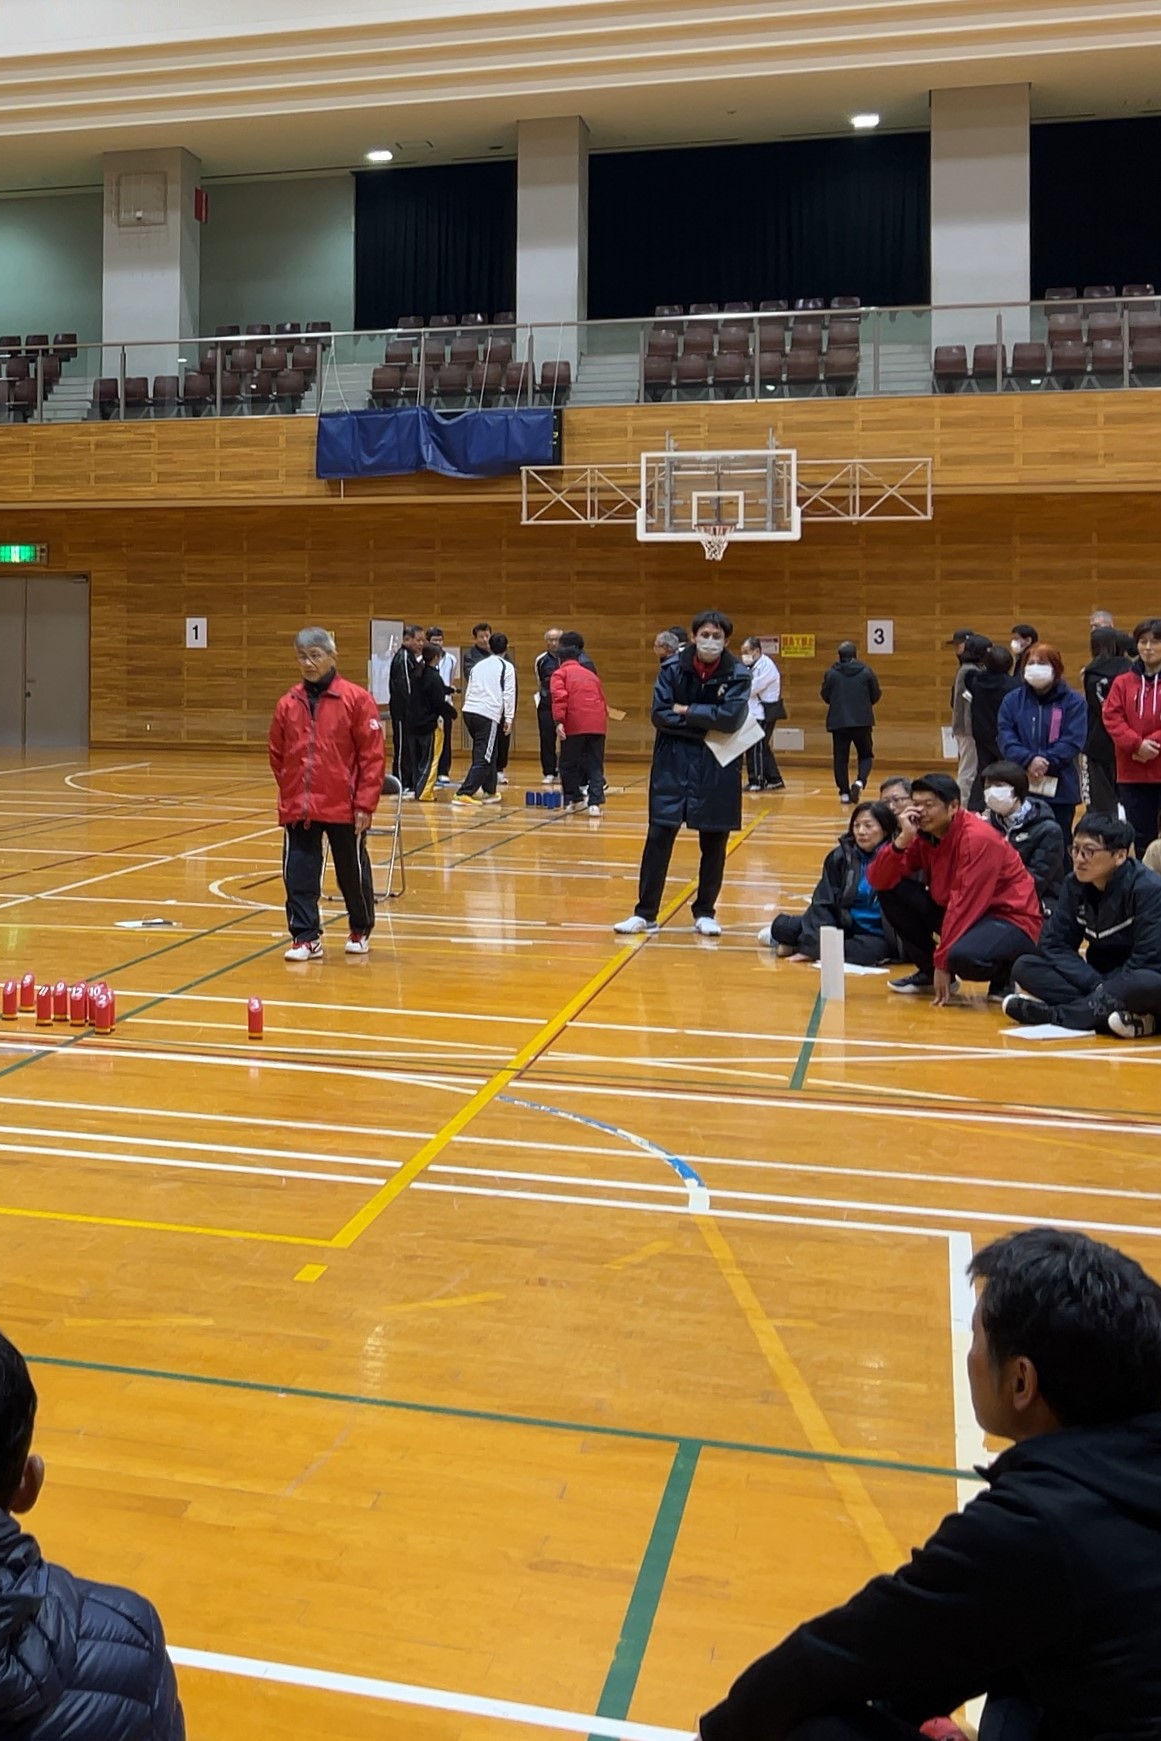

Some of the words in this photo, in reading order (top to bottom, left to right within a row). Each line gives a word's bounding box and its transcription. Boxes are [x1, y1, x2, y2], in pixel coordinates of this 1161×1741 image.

[192, 624, 199, 640] 1
[873, 628, 885, 645] 3
[23, 975, 32, 984] 5
[7, 982, 13, 991] 1
[39, 986, 49, 996] 11
[56, 982, 64, 991] 9
[71, 987, 82, 996] 12
[89, 987, 100, 996] 10
[98, 995, 106, 1004] 2
[251, 999, 260, 1009] 3
